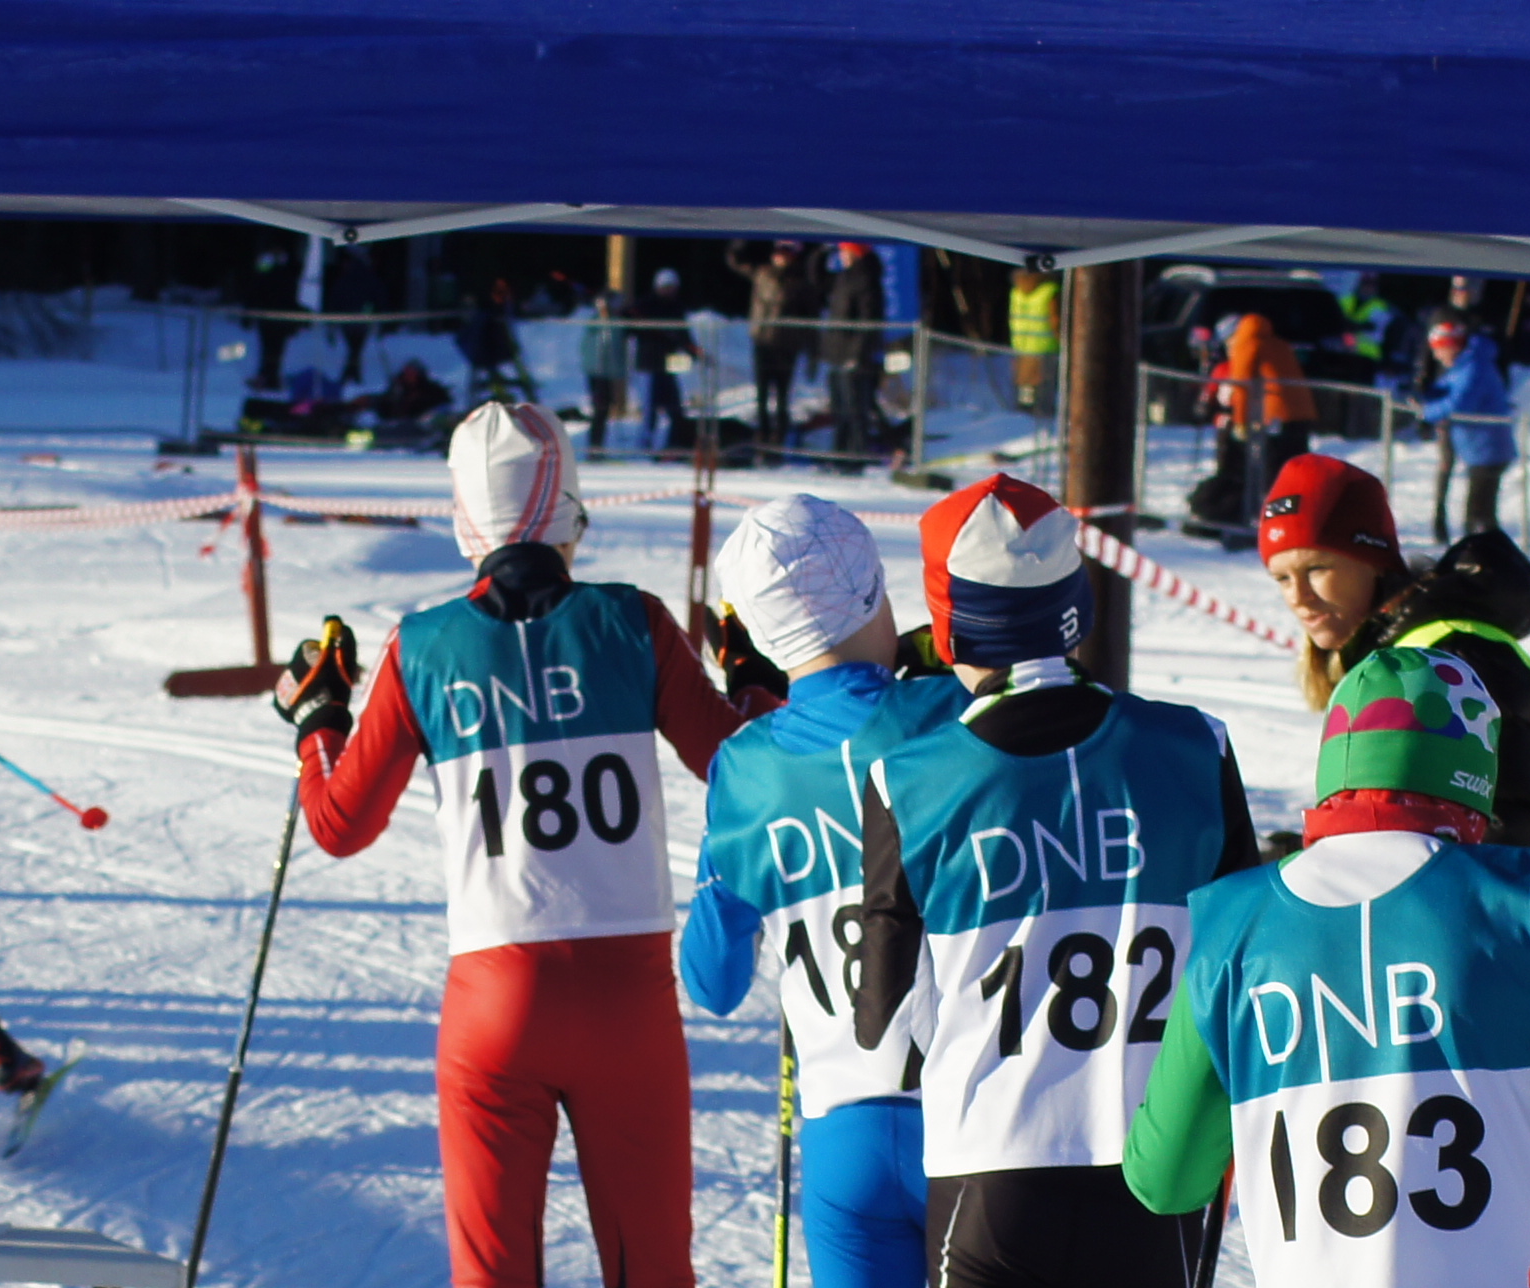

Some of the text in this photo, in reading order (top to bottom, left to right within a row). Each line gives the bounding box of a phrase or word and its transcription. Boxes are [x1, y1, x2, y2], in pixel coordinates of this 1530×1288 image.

[442, 622, 586, 748] DNB
[472, 752, 640, 858] 180
[766, 739, 863, 890] DN
[970, 747, 1146, 915] DNB
[785, 904, 863, 1016] 18
[980, 925, 1176, 1057] 182
[1248, 900, 1444, 1084] DNB
[1270, 1094, 1492, 1242] 183
